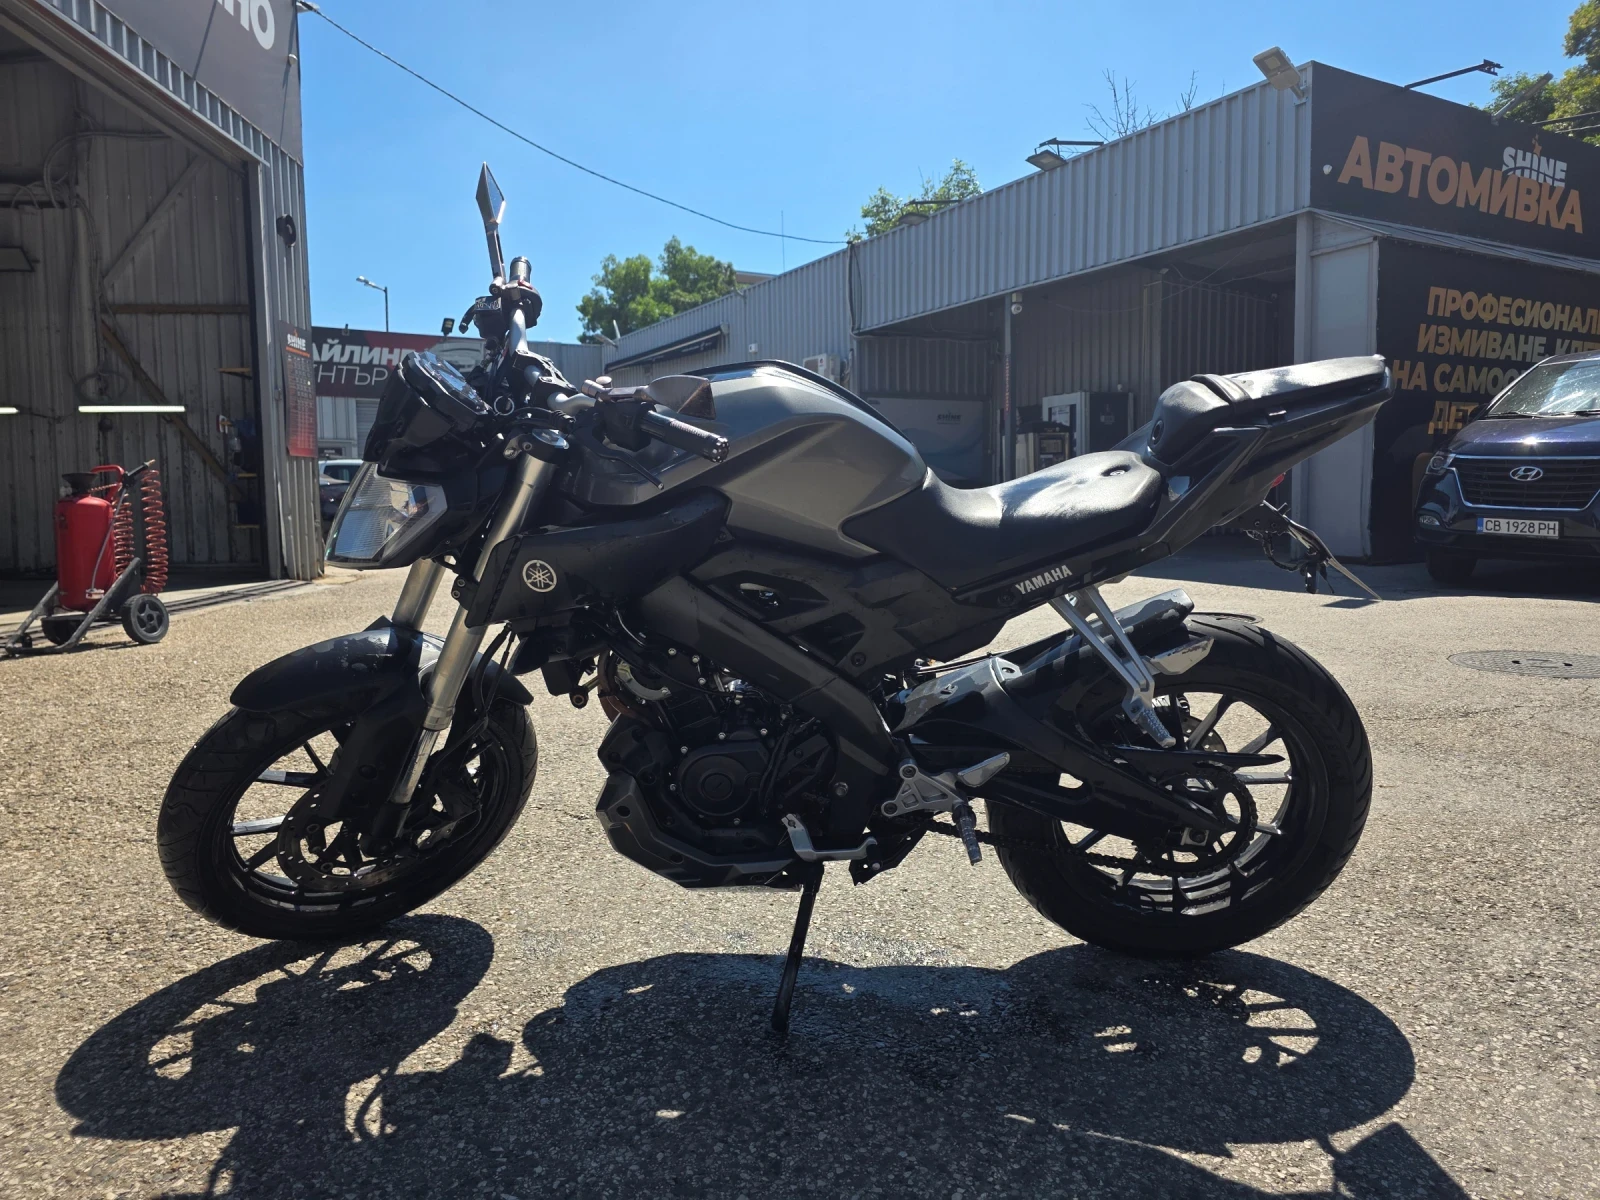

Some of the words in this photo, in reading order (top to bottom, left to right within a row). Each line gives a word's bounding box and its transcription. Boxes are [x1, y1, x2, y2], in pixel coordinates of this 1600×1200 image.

[1502, 146, 1567, 188] SHINE
[1337, 135, 1583, 234] АВТОМИВКА
[313, 364, 388, 386] НТЪР
[1393, 360, 1427, 391] НА
[1434, 363, 1528, 395] САМОО
[1485, 519, 1501, 532] CB
[1506, 521, 1535, 534] 1928
[1538, 522, 1556, 535] PH
[1015, 565, 1073, 595] YAMAHA
